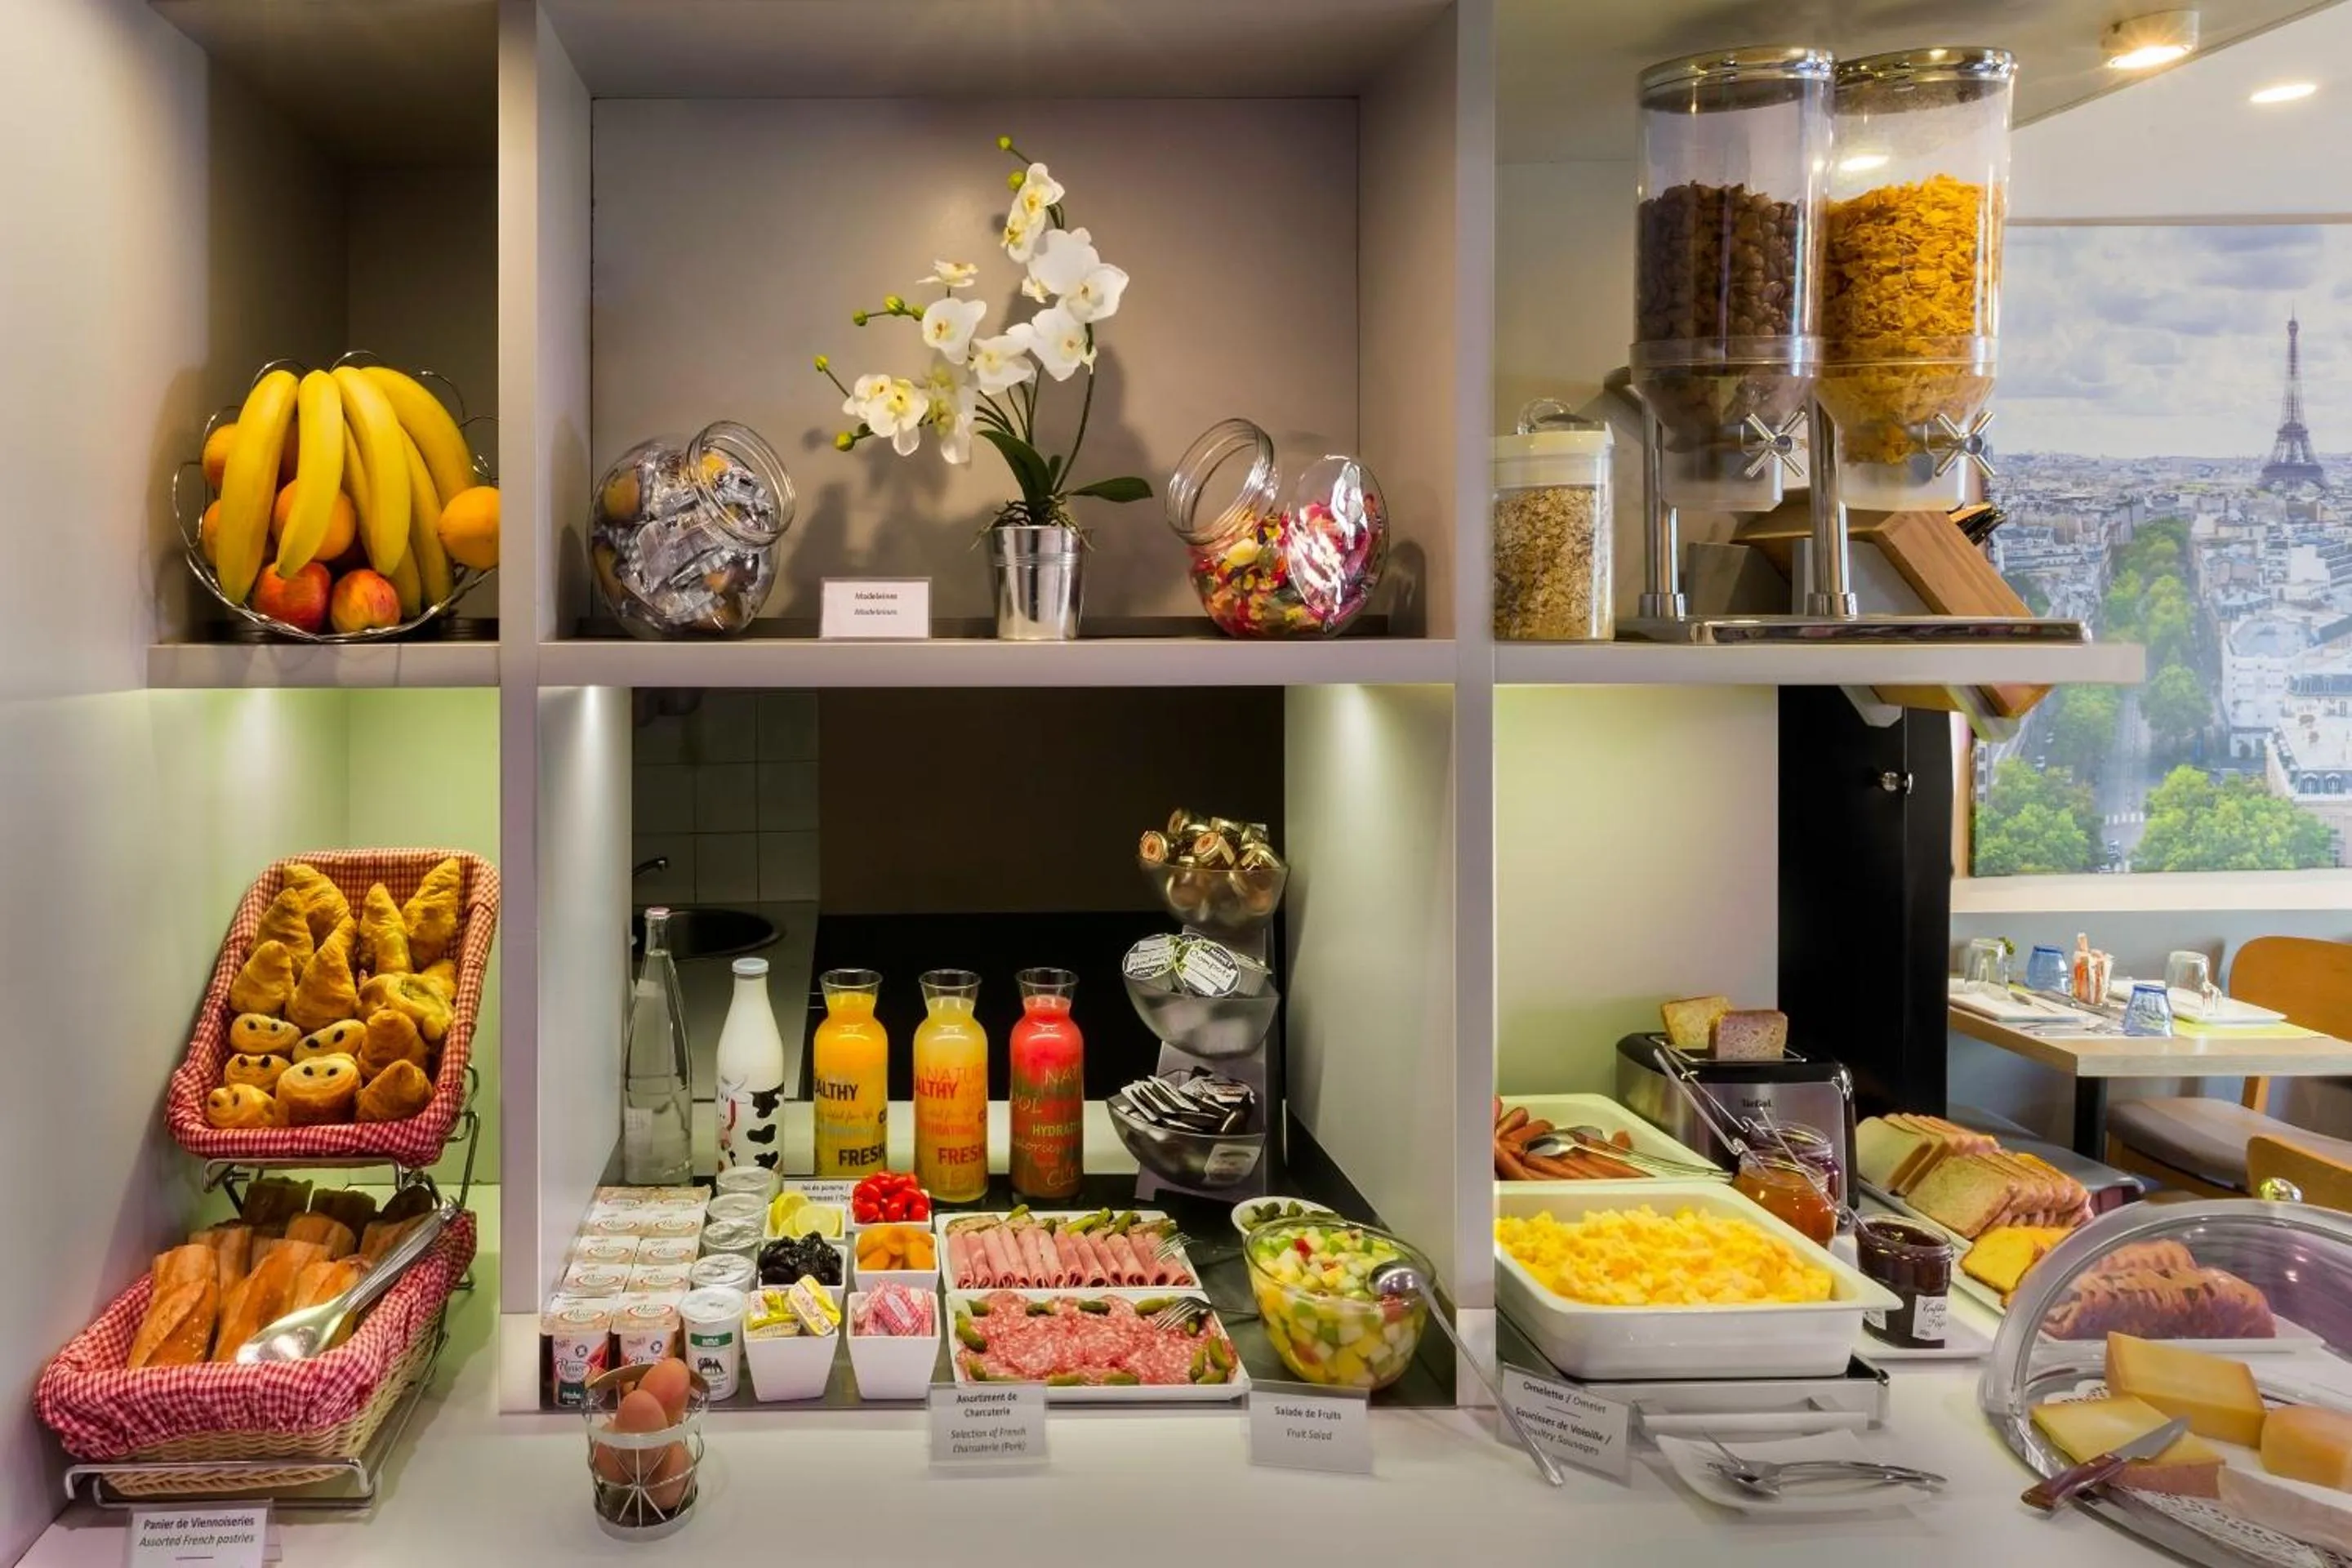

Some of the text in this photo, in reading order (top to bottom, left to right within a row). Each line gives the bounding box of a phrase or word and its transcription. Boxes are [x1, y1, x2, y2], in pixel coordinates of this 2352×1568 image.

[1523, 1381, 1564, 1401] Omelette
[1274, 1406, 1341, 1420] Salade de Fruits
[1557, 1420, 1568, 1430] de
[951, 1429, 987, 1439] Selection
[989, 1428, 998, 1439] of
[1286, 1428, 1332, 1441] Fruit Salad
[144, 1516, 255, 1530] Panier de Viennoiseries
[139, 1533, 255, 1547] Assorted French pastries
